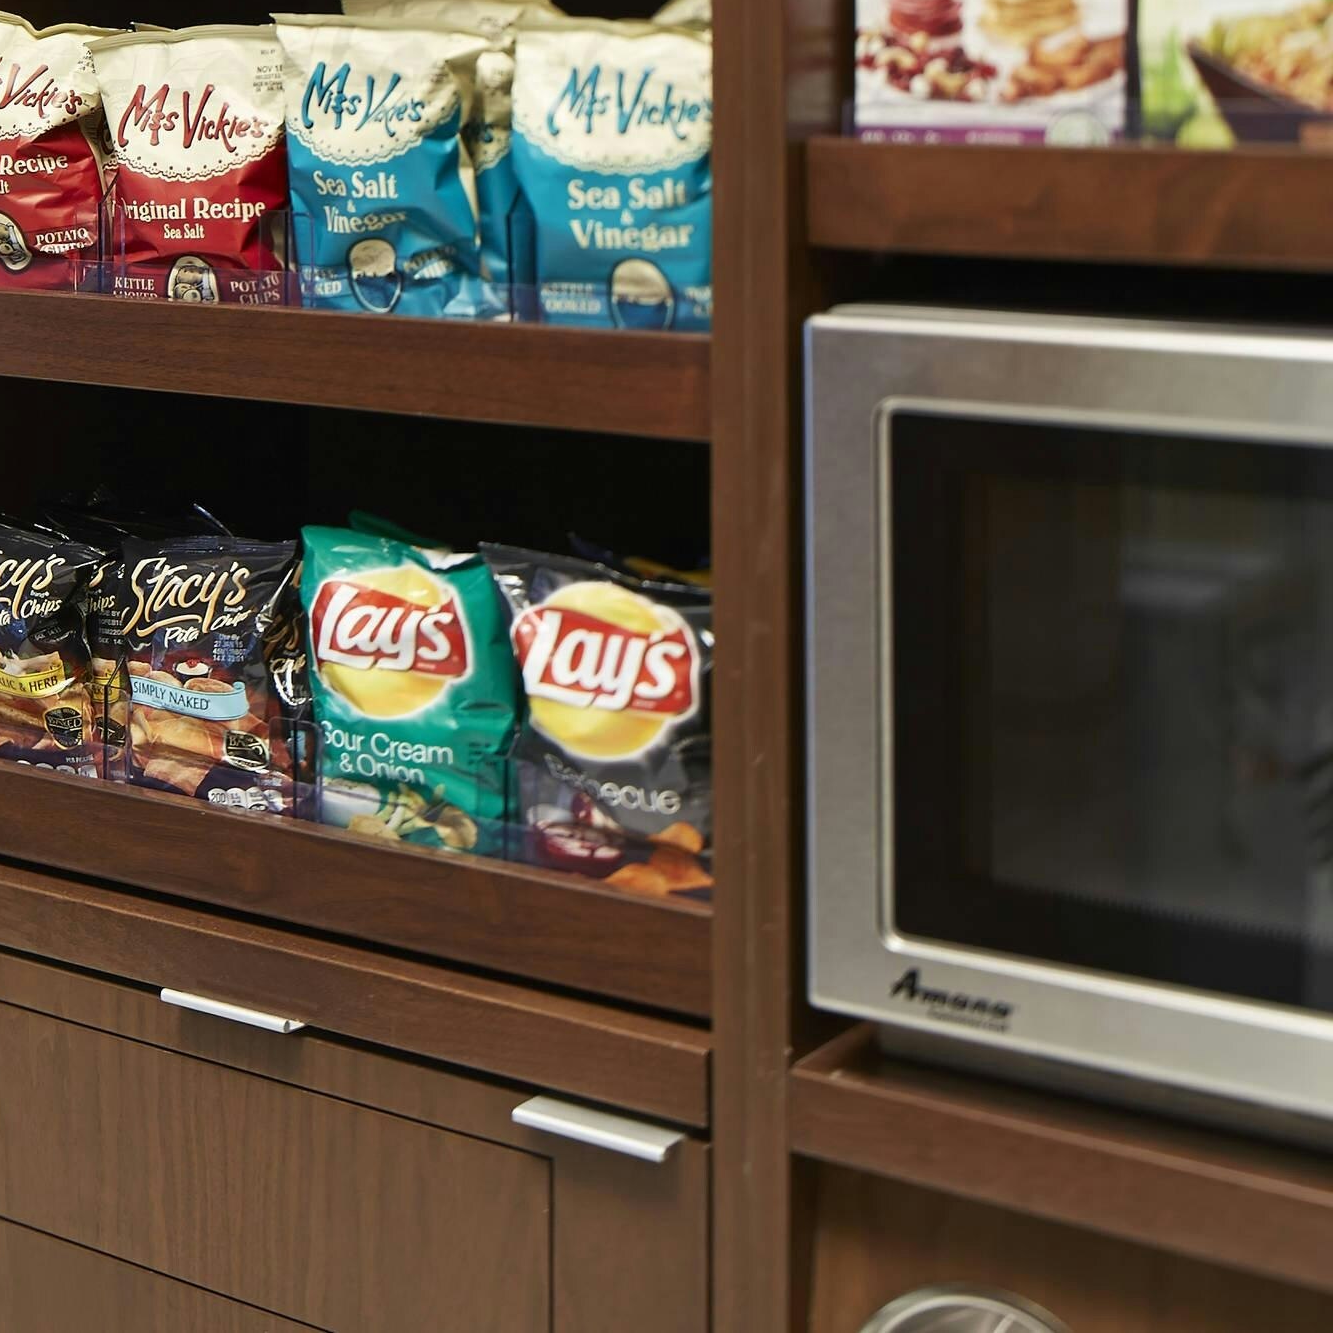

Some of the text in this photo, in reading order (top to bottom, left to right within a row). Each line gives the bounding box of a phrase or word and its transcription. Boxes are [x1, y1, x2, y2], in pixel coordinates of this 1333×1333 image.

[256, 65, 273, 73] NOV
[301, 61, 426, 138] Miss Vkie's
[547, 65, 611, 136] Miss
[117, 83, 270, 153] Miss Vickie's
[0, 154, 69, 177] Recipe
[313, 170, 399, 200] Sea Salt
[567, 178, 687, 210] Sea Salt
[121, 196, 267, 223] riginal Recipe
[323, 205, 408, 234] Vinegar
[347, 199, 357, 213] &
[36, 227, 88, 246] POTATO
[164, 223, 205, 239] Sea Salt
[570, 219, 694, 252] Vinegar
[114, 276, 155, 291] KETTLE
[20, 597, 63, 619] Chips
[88, 595, 116, 612] hips
[121, 556, 250, 635] Stacy's
[164, 626, 201, 648] Pita
[317, 584, 454, 672] Lay's
[522, 609, 687, 711] Lay's
[18, 682, 27, 692] &
[28, 675, 59, 692] HERB
[133, 682, 210, 711] SIMPLY NAKED
[321, 720, 454, 765] Sour Cream
[339, 752, 425, 785] & Onion
[211, 792, 226, 803] 200
[544, 752, 682, 815] Bbecue
